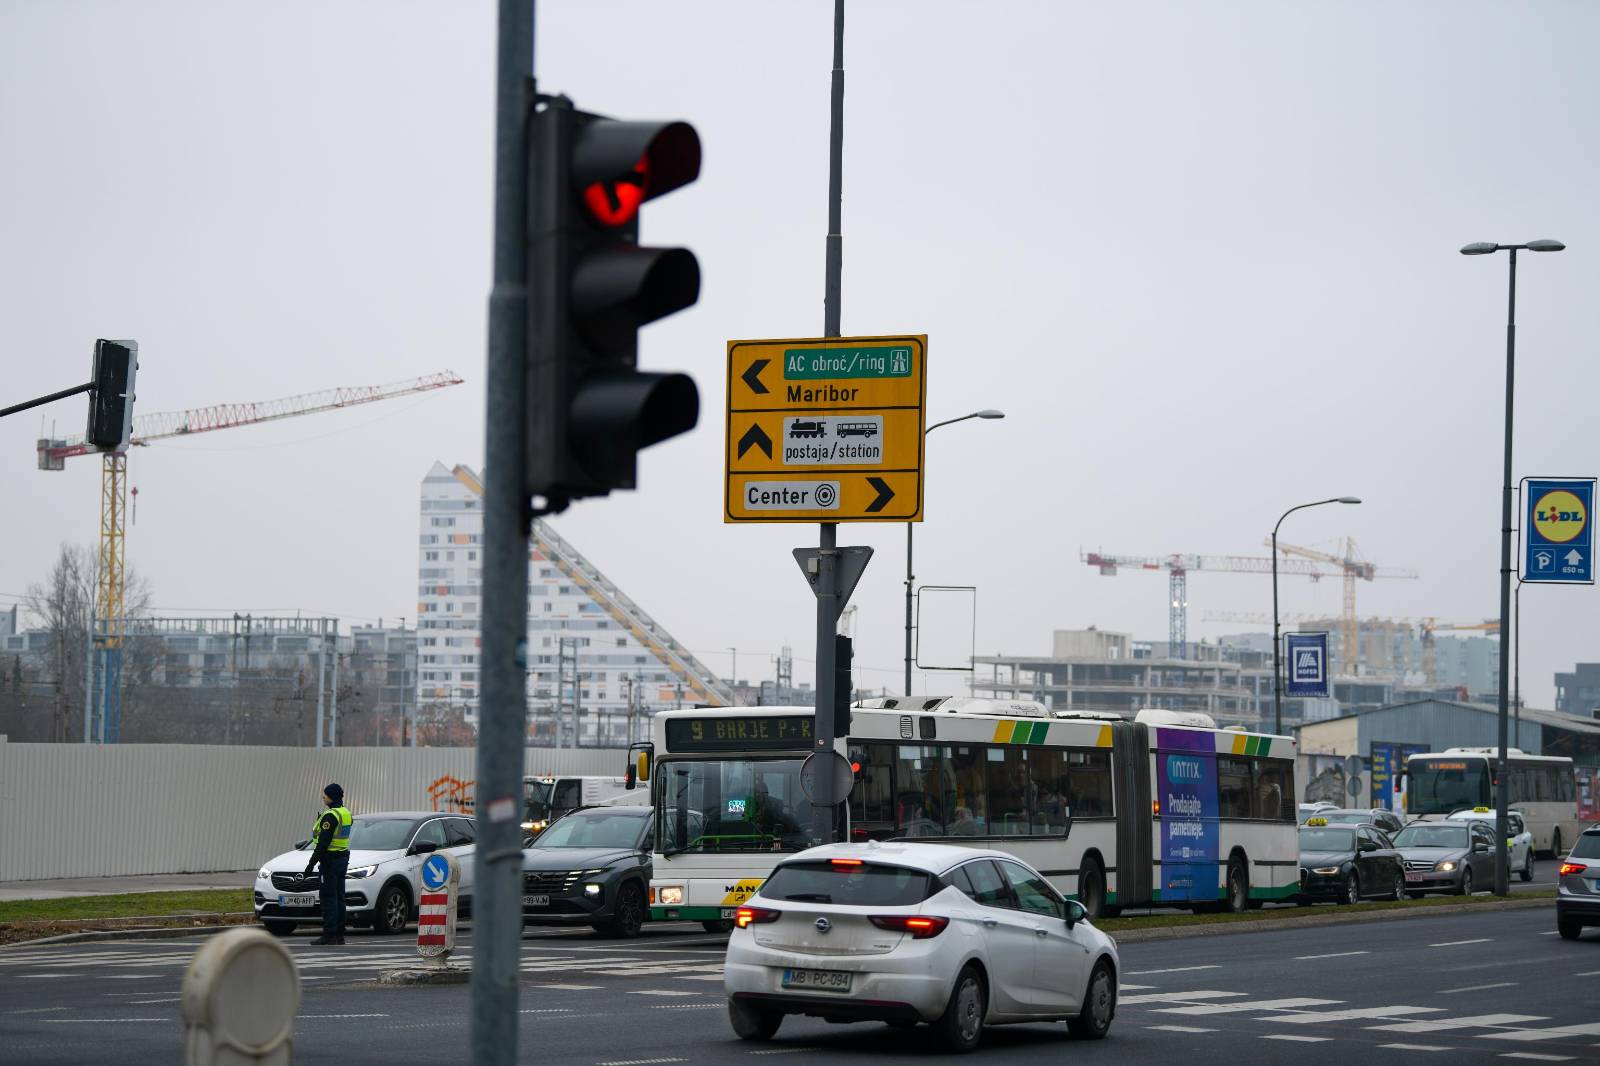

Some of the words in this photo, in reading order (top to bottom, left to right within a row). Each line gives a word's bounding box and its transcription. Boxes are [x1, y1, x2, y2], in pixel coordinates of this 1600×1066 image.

[788, 355, 806, 372] AC
[812, 351, 886, 374] obroč/ring
[787, 385, 859, 403] Maribor
[785, 442, 880, 462] postaja/station
[747, 487, 808, 505] Center
[691, 720, 704, 741] 9
[716, 719, 769, 739] BARJE
[1168, 793, 1202, 816] Prodajajte
[790, 971, 807, 984] MB
[812, 972, 849, 987] PC-094
